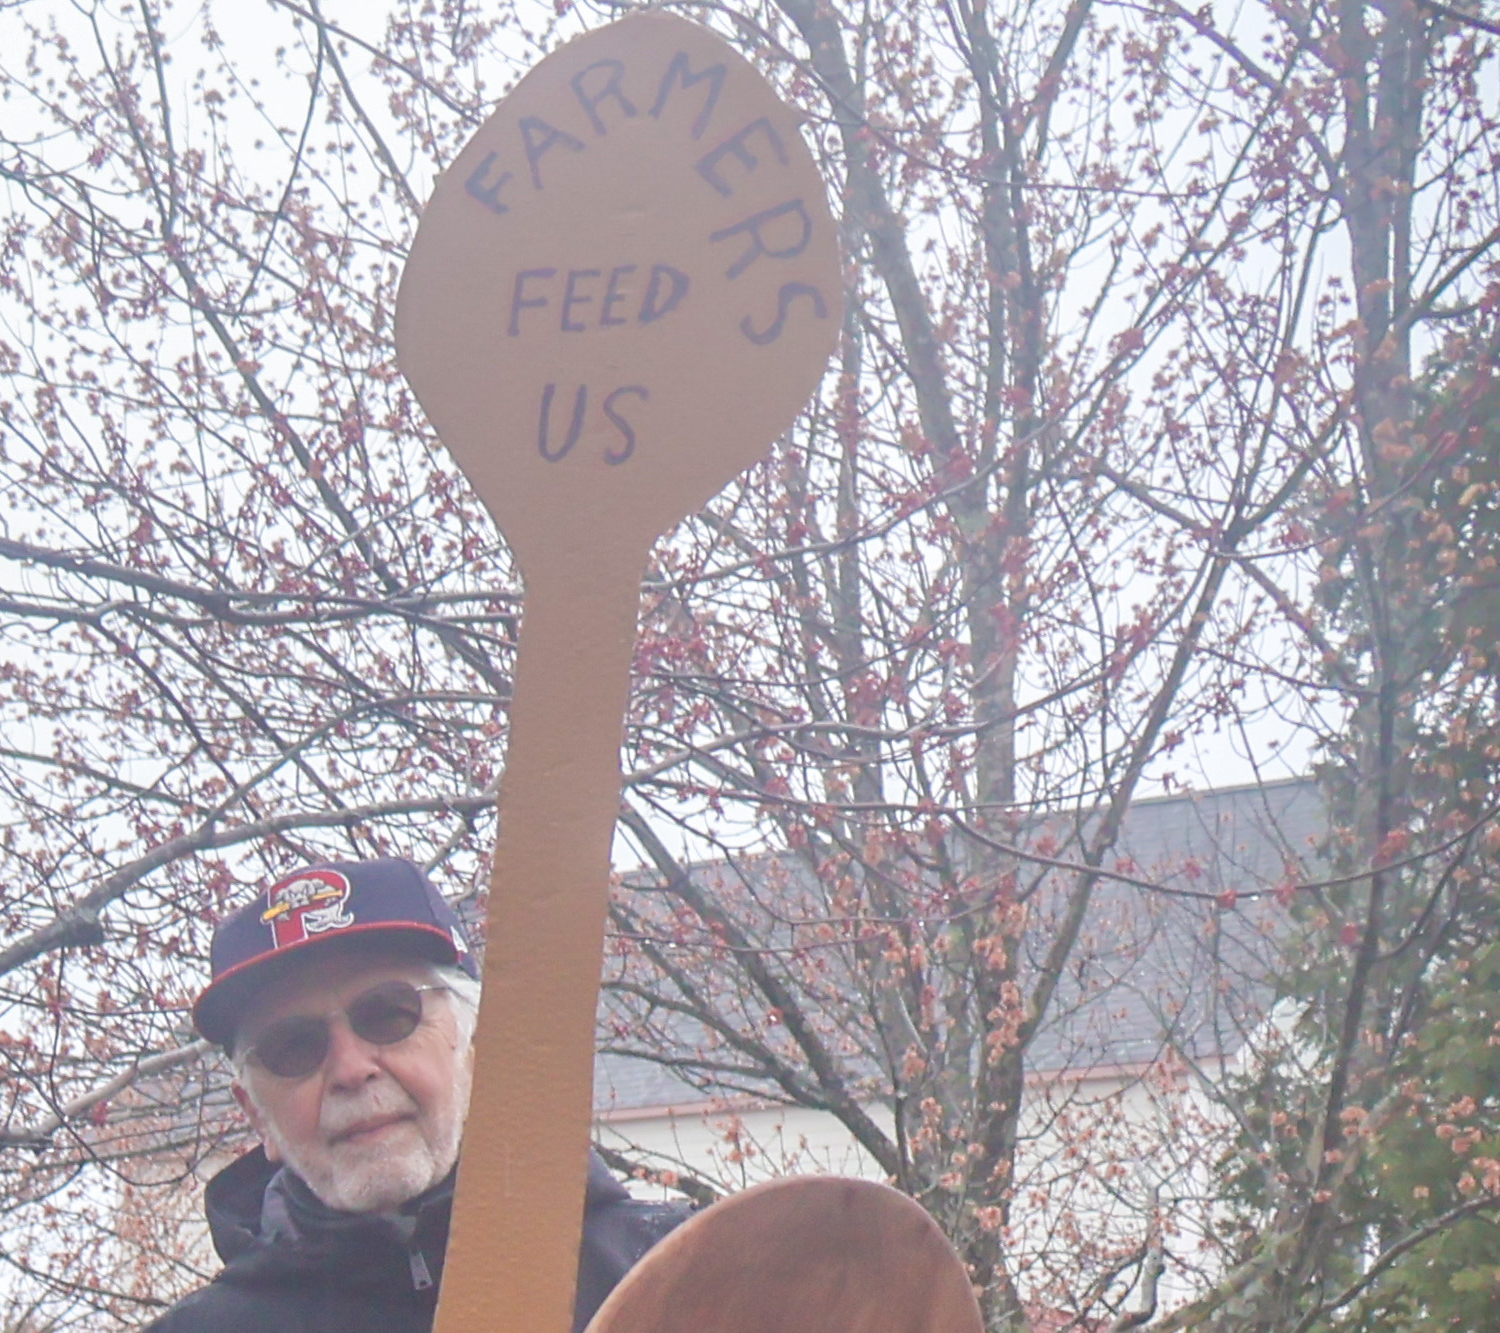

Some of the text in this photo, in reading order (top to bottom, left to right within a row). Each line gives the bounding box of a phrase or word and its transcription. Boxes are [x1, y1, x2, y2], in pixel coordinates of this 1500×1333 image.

[465, 50, 829, 346] FARMERS
[506, 262, 691, 338] FEED
[537, 382, 650, 466] US
